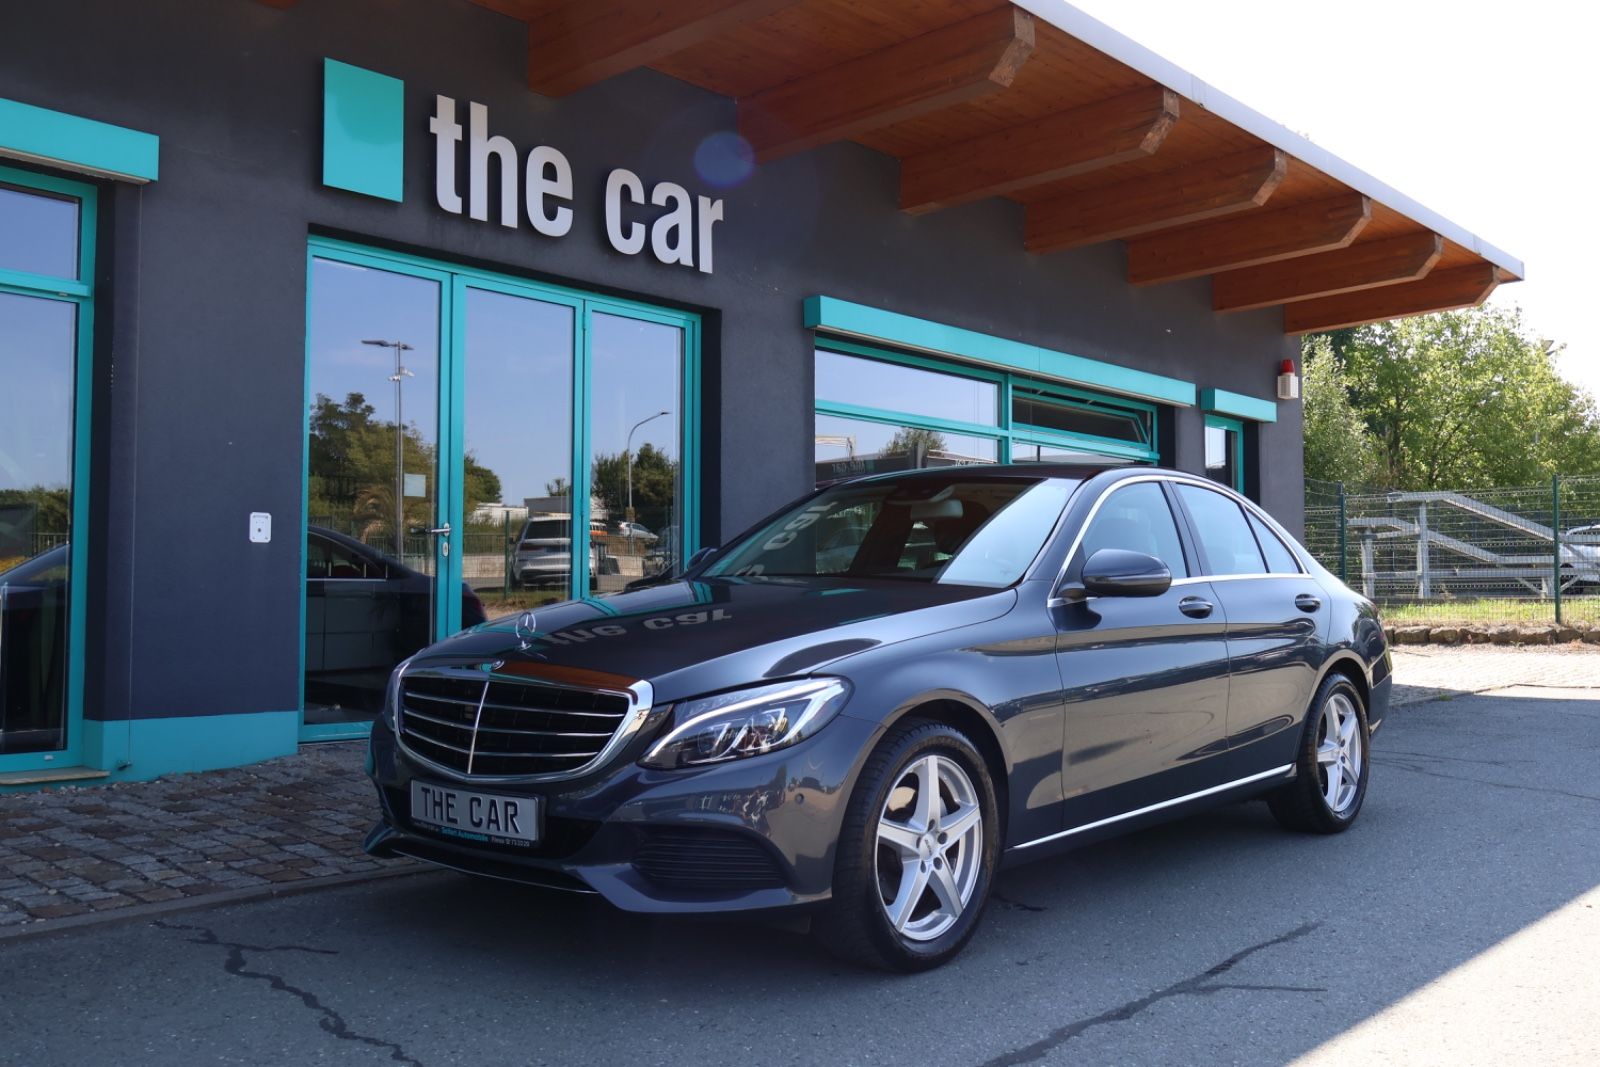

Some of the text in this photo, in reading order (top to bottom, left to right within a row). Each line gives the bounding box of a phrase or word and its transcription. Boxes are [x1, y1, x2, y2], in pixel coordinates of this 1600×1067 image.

[430, 94, 724, 274] the car
[421, 787, 458, 824] THE
[470, 797, 521, 834] CAR
